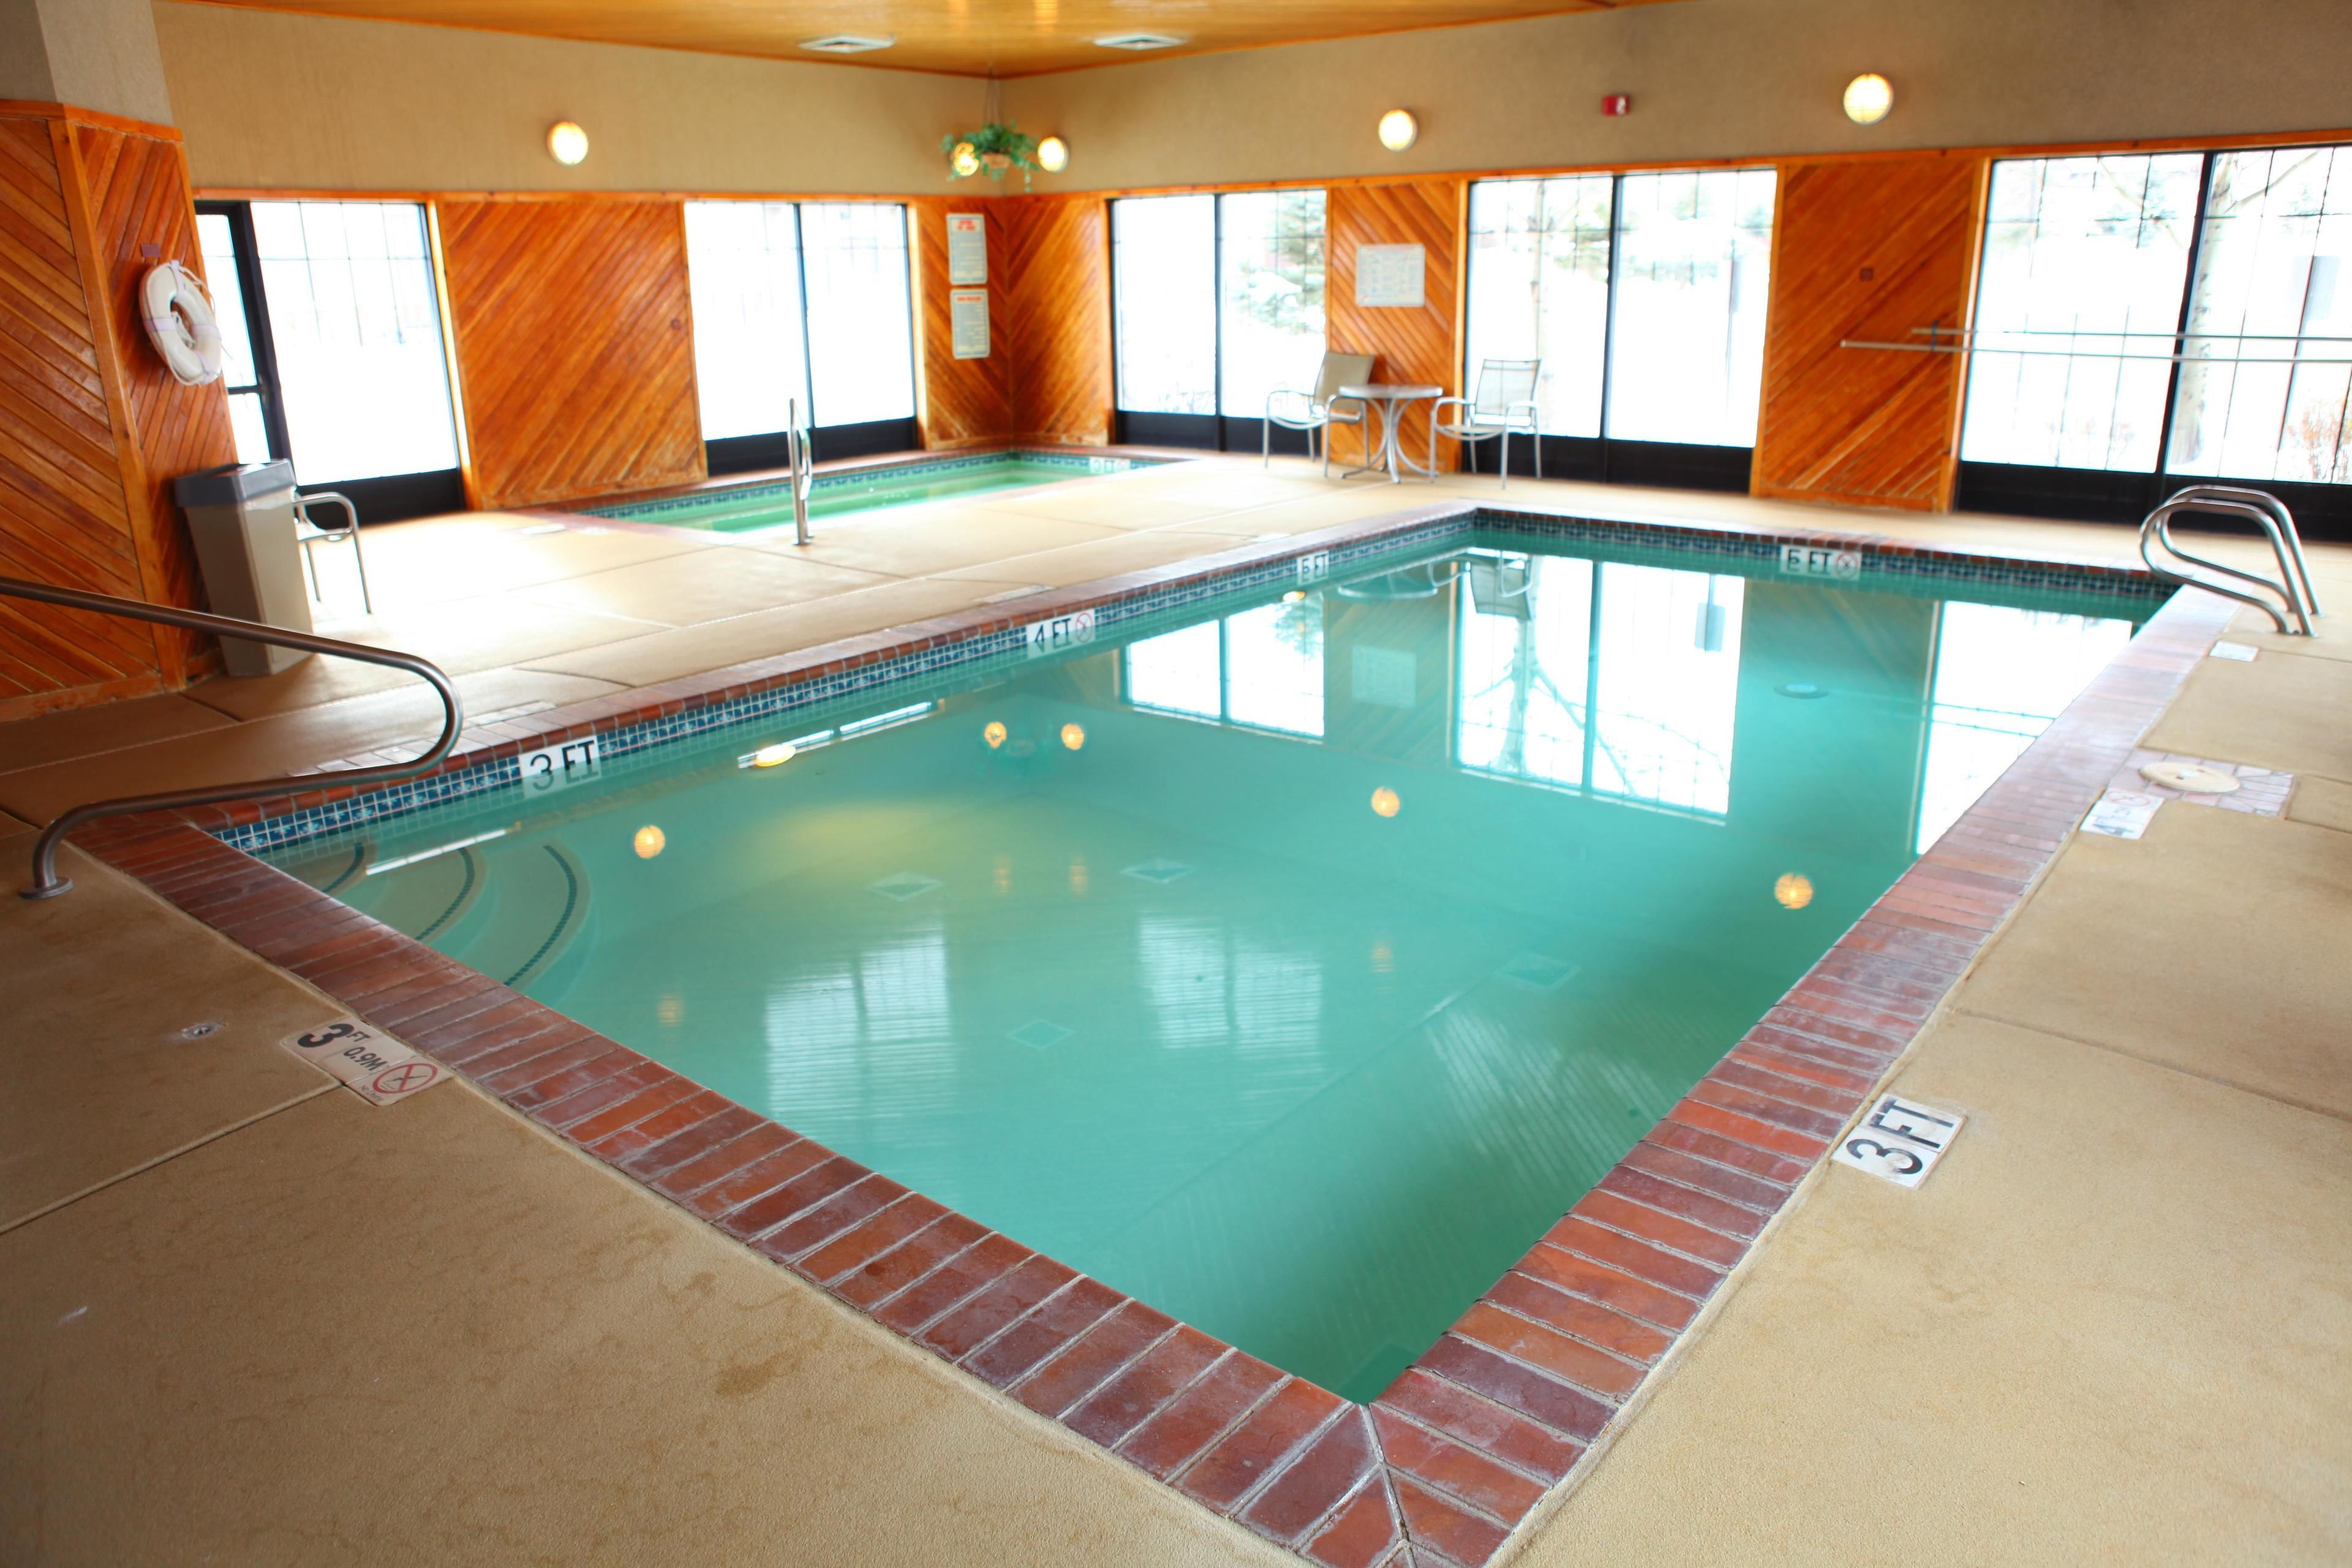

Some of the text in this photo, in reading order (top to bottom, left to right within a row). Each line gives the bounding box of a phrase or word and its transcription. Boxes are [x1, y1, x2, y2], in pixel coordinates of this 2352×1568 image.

[1788, 549, 1833, 568] 5 FT
[1052, 618, 1072, 638] FT
[530, 741, 594, 775] 3 FT
[2092, 823, 2134, 837] 4
[297, 1023, 371, 1048] 3 FT
[343, 1047, 387, 1071] 0.9M
[1846, 1097, 1954, 1174] 3 FT
